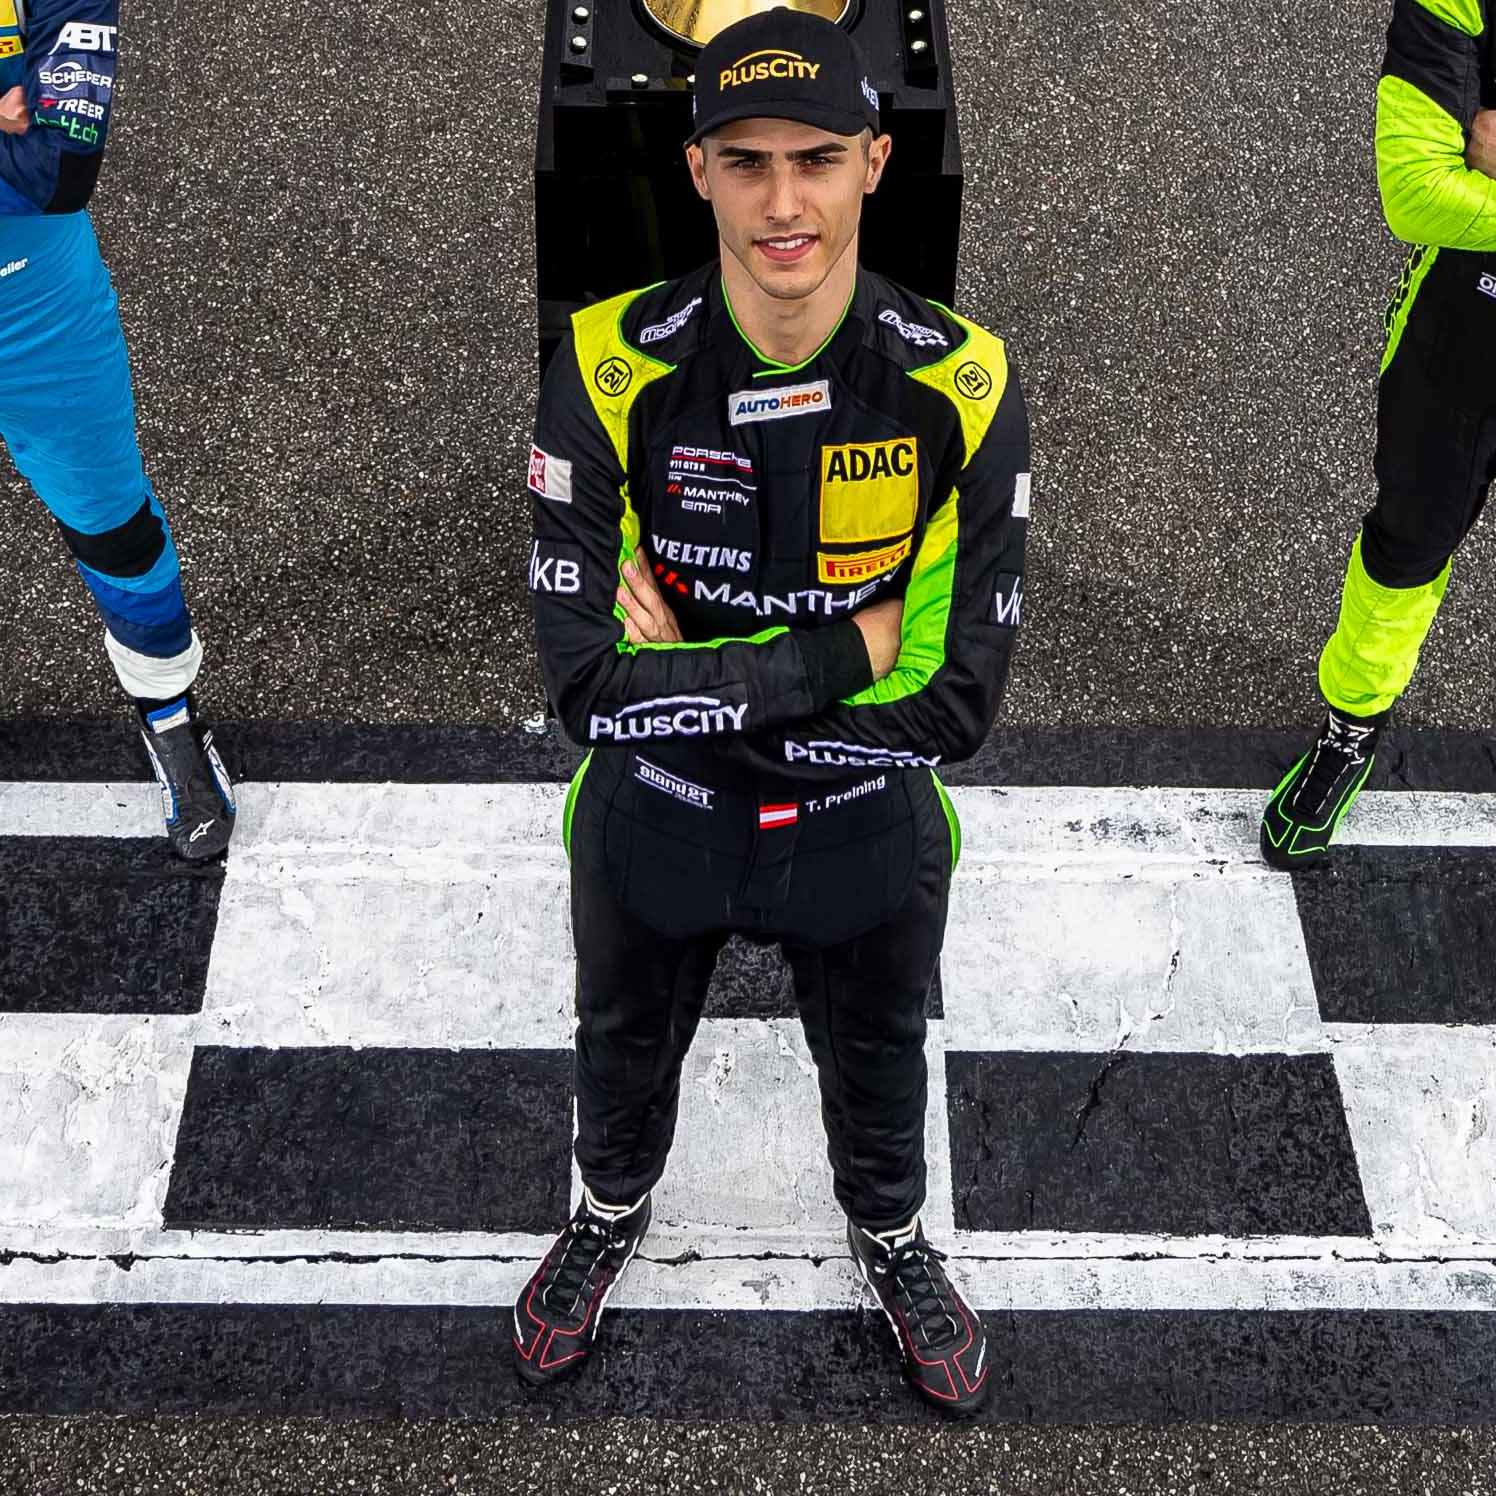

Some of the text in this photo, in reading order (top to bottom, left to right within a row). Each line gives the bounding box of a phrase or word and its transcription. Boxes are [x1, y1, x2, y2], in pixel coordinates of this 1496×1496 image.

[47, 21, 117, 56] ABT
[603, 363, 625, 391] 21
[961, 369, 986, 393] 21
[734, 390, 824, 417] AUTOHERO
[825, 442, 915, 484] ADAC
[680, 499, 723, 515] EMA
[683, 485, 751, 507] MANTHEY
[651, 534, 753, 573] VELTINS
[588, 702, 749, 742] PLUSCITY
[804, 774, 887, 814] T. Preining
